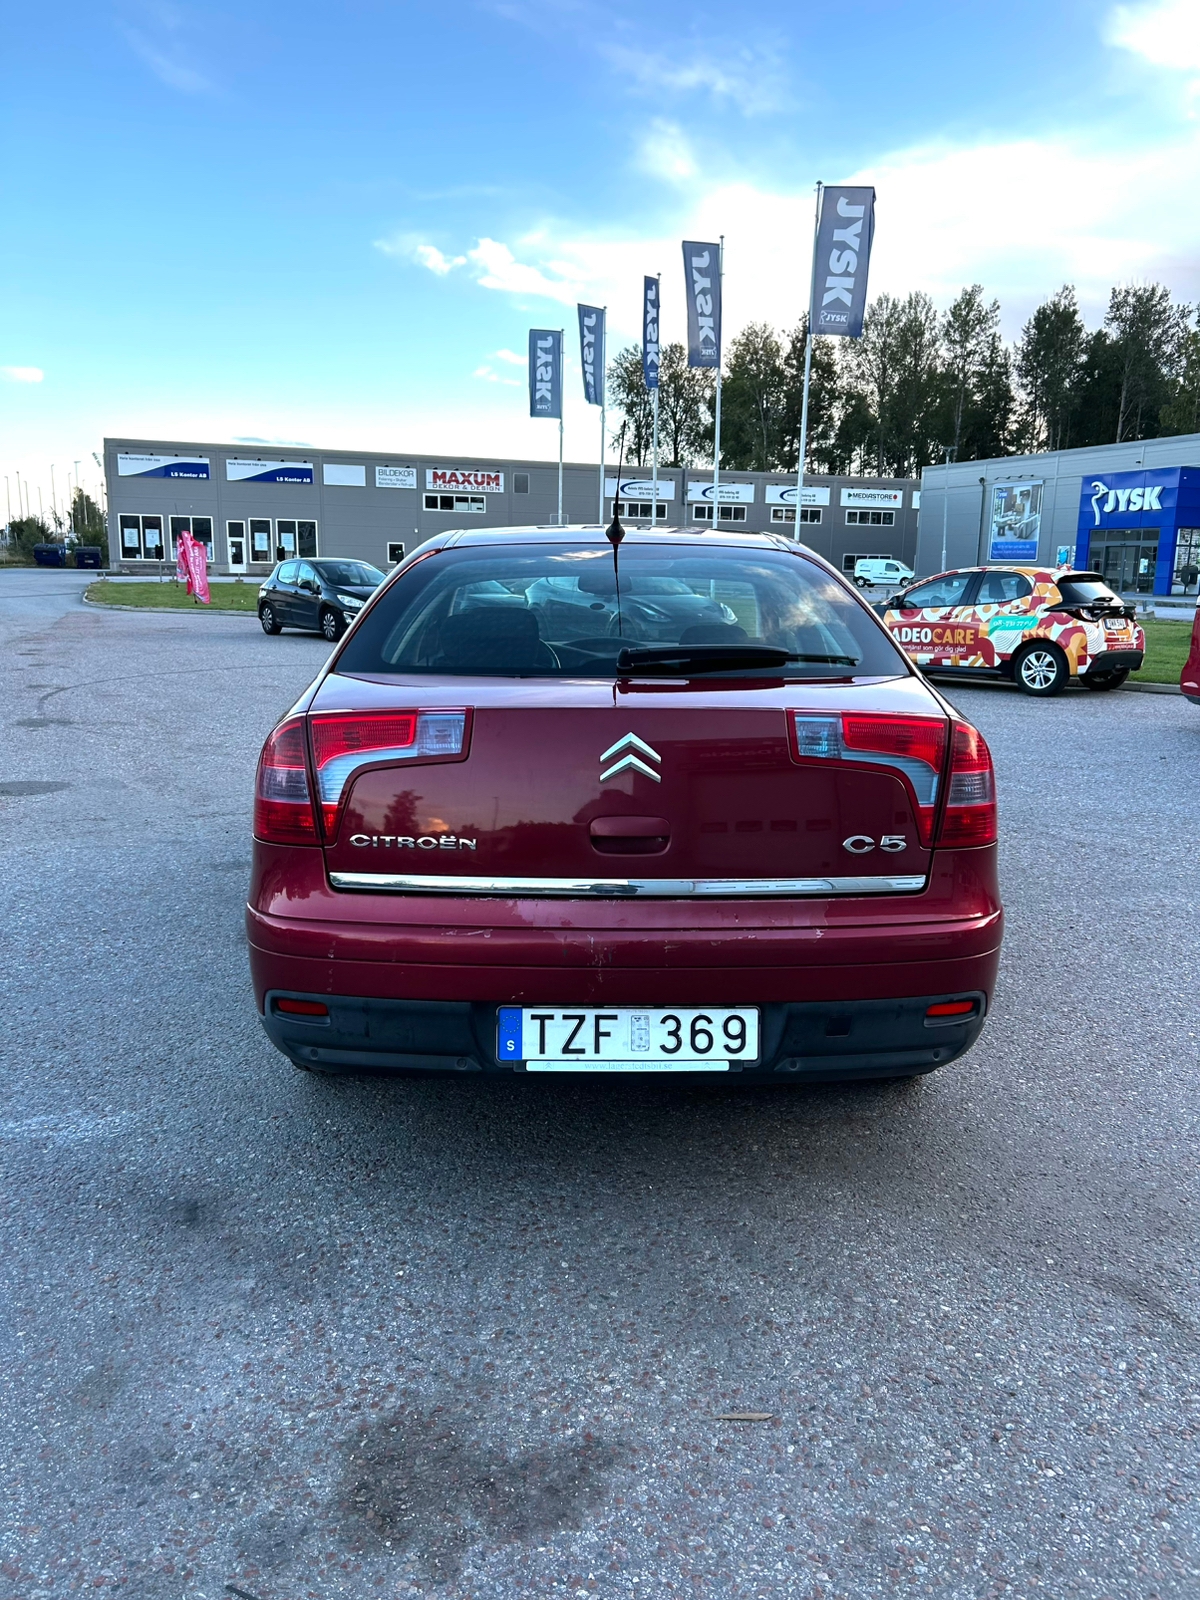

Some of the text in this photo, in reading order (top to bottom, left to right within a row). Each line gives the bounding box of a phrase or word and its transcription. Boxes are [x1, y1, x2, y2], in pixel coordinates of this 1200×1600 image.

[820, 196, 865, 307] JYSK
[825, 314, 847, 323] JYSK
[378, 469, 414, 478] BILDEKOR
[432, 471, 500, 487] MAXUM
[852, 492, 893, 500] MEDIASTORE
[1103, 486, 1165, 513] JYSK
[892, 627, 975, 644] ADEOCARE
[901, 644, 921, 652] emtjänst
[934, 645, 943, 653] gör
[945, 645, 953, 653] dig
[955, 645, 966, 653] glad
[349, 834, 477, 850] CITROËN
[842, 835, 908, 854] C5
[530, 1014, 618, 1055] TZF
[659, 1014, 747, 1055] 369
[506, 1040, 515, 1051] S
